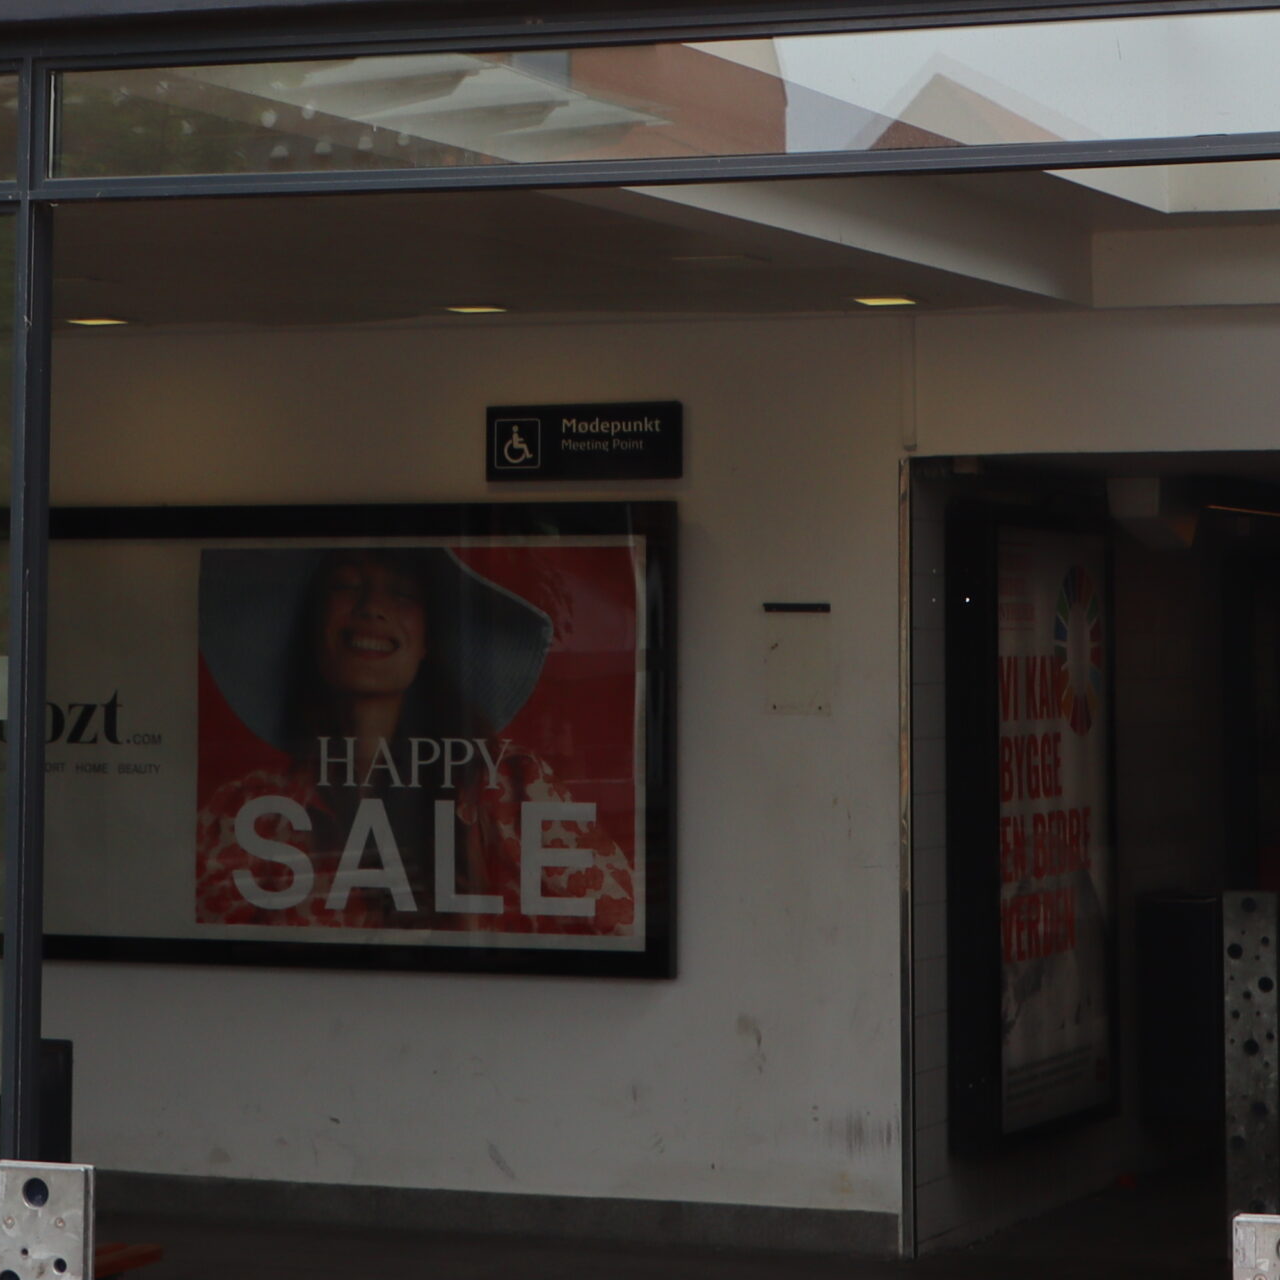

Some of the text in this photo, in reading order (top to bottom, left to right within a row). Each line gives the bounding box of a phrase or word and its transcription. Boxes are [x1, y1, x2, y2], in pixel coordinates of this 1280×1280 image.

[561, 417, 662, 436] Mødepunkt
[561, 438, 645, 452] Meeting Point
[999, 655, 1064, 722] VI KAN
[75, 761, 109, 774] HOME
[117, 762, 161, 775] BEAUTY
[316, 735, 514, 790] HAPPY
[1000, 732, 1063, 803] BYGGE
[231, 795, 599, 918] SALE
[1000, 806, 1092, 883] EN BEDRE
[1001, 885, 1077, 963] VERDEN
